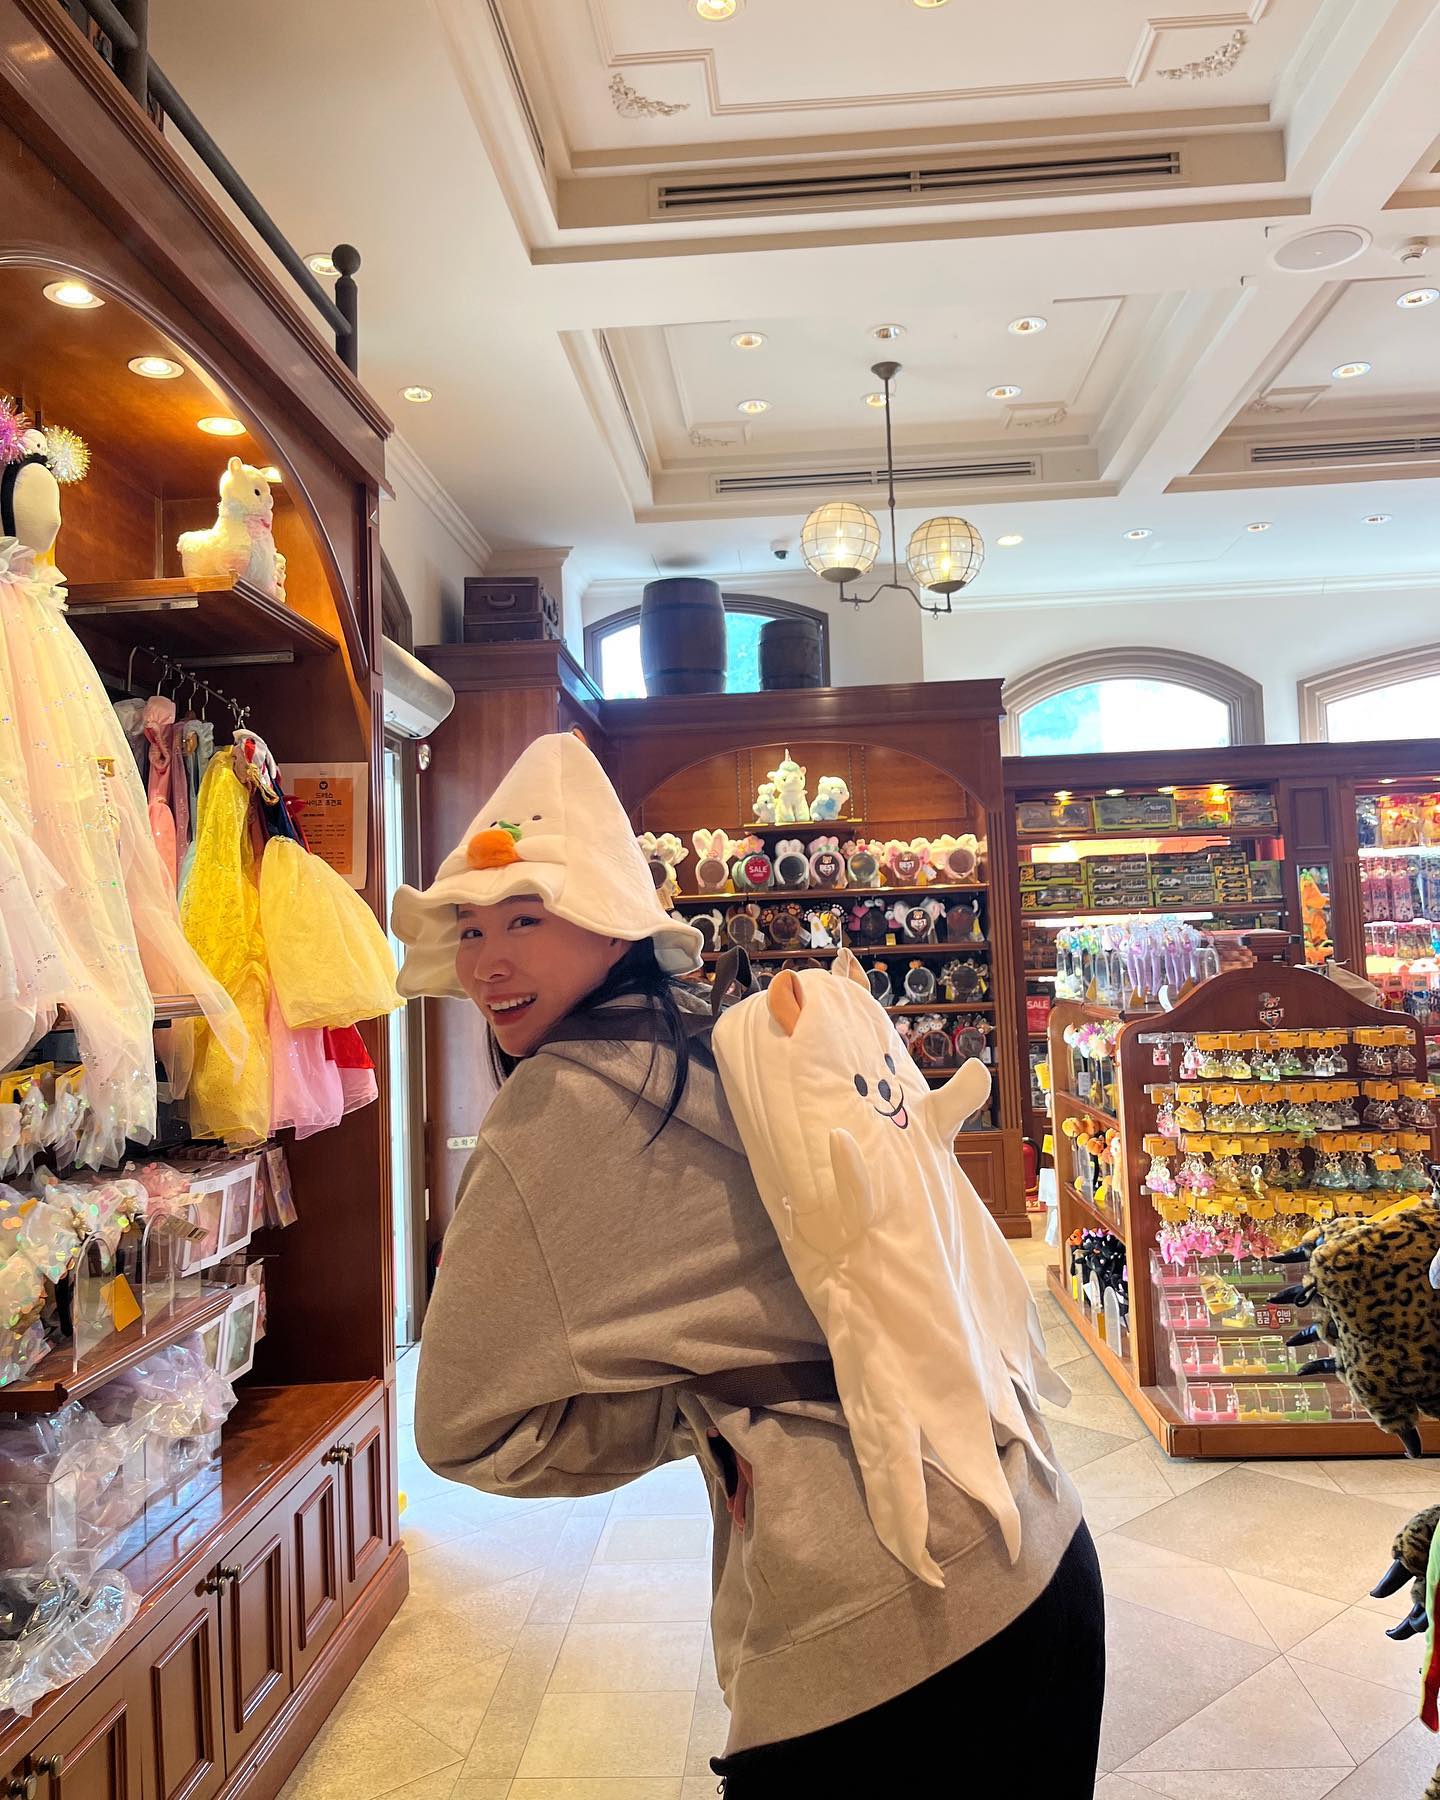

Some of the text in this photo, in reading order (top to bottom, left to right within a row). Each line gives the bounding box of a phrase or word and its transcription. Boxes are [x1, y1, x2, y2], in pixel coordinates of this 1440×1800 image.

[748, 865, 768, 873] SALE
[1026, 1000, 1049, 1009] SALE
[1259, 1008, 1285, 1020] BEST
[1256, 1309, 1291, 1325] 품절 임박
